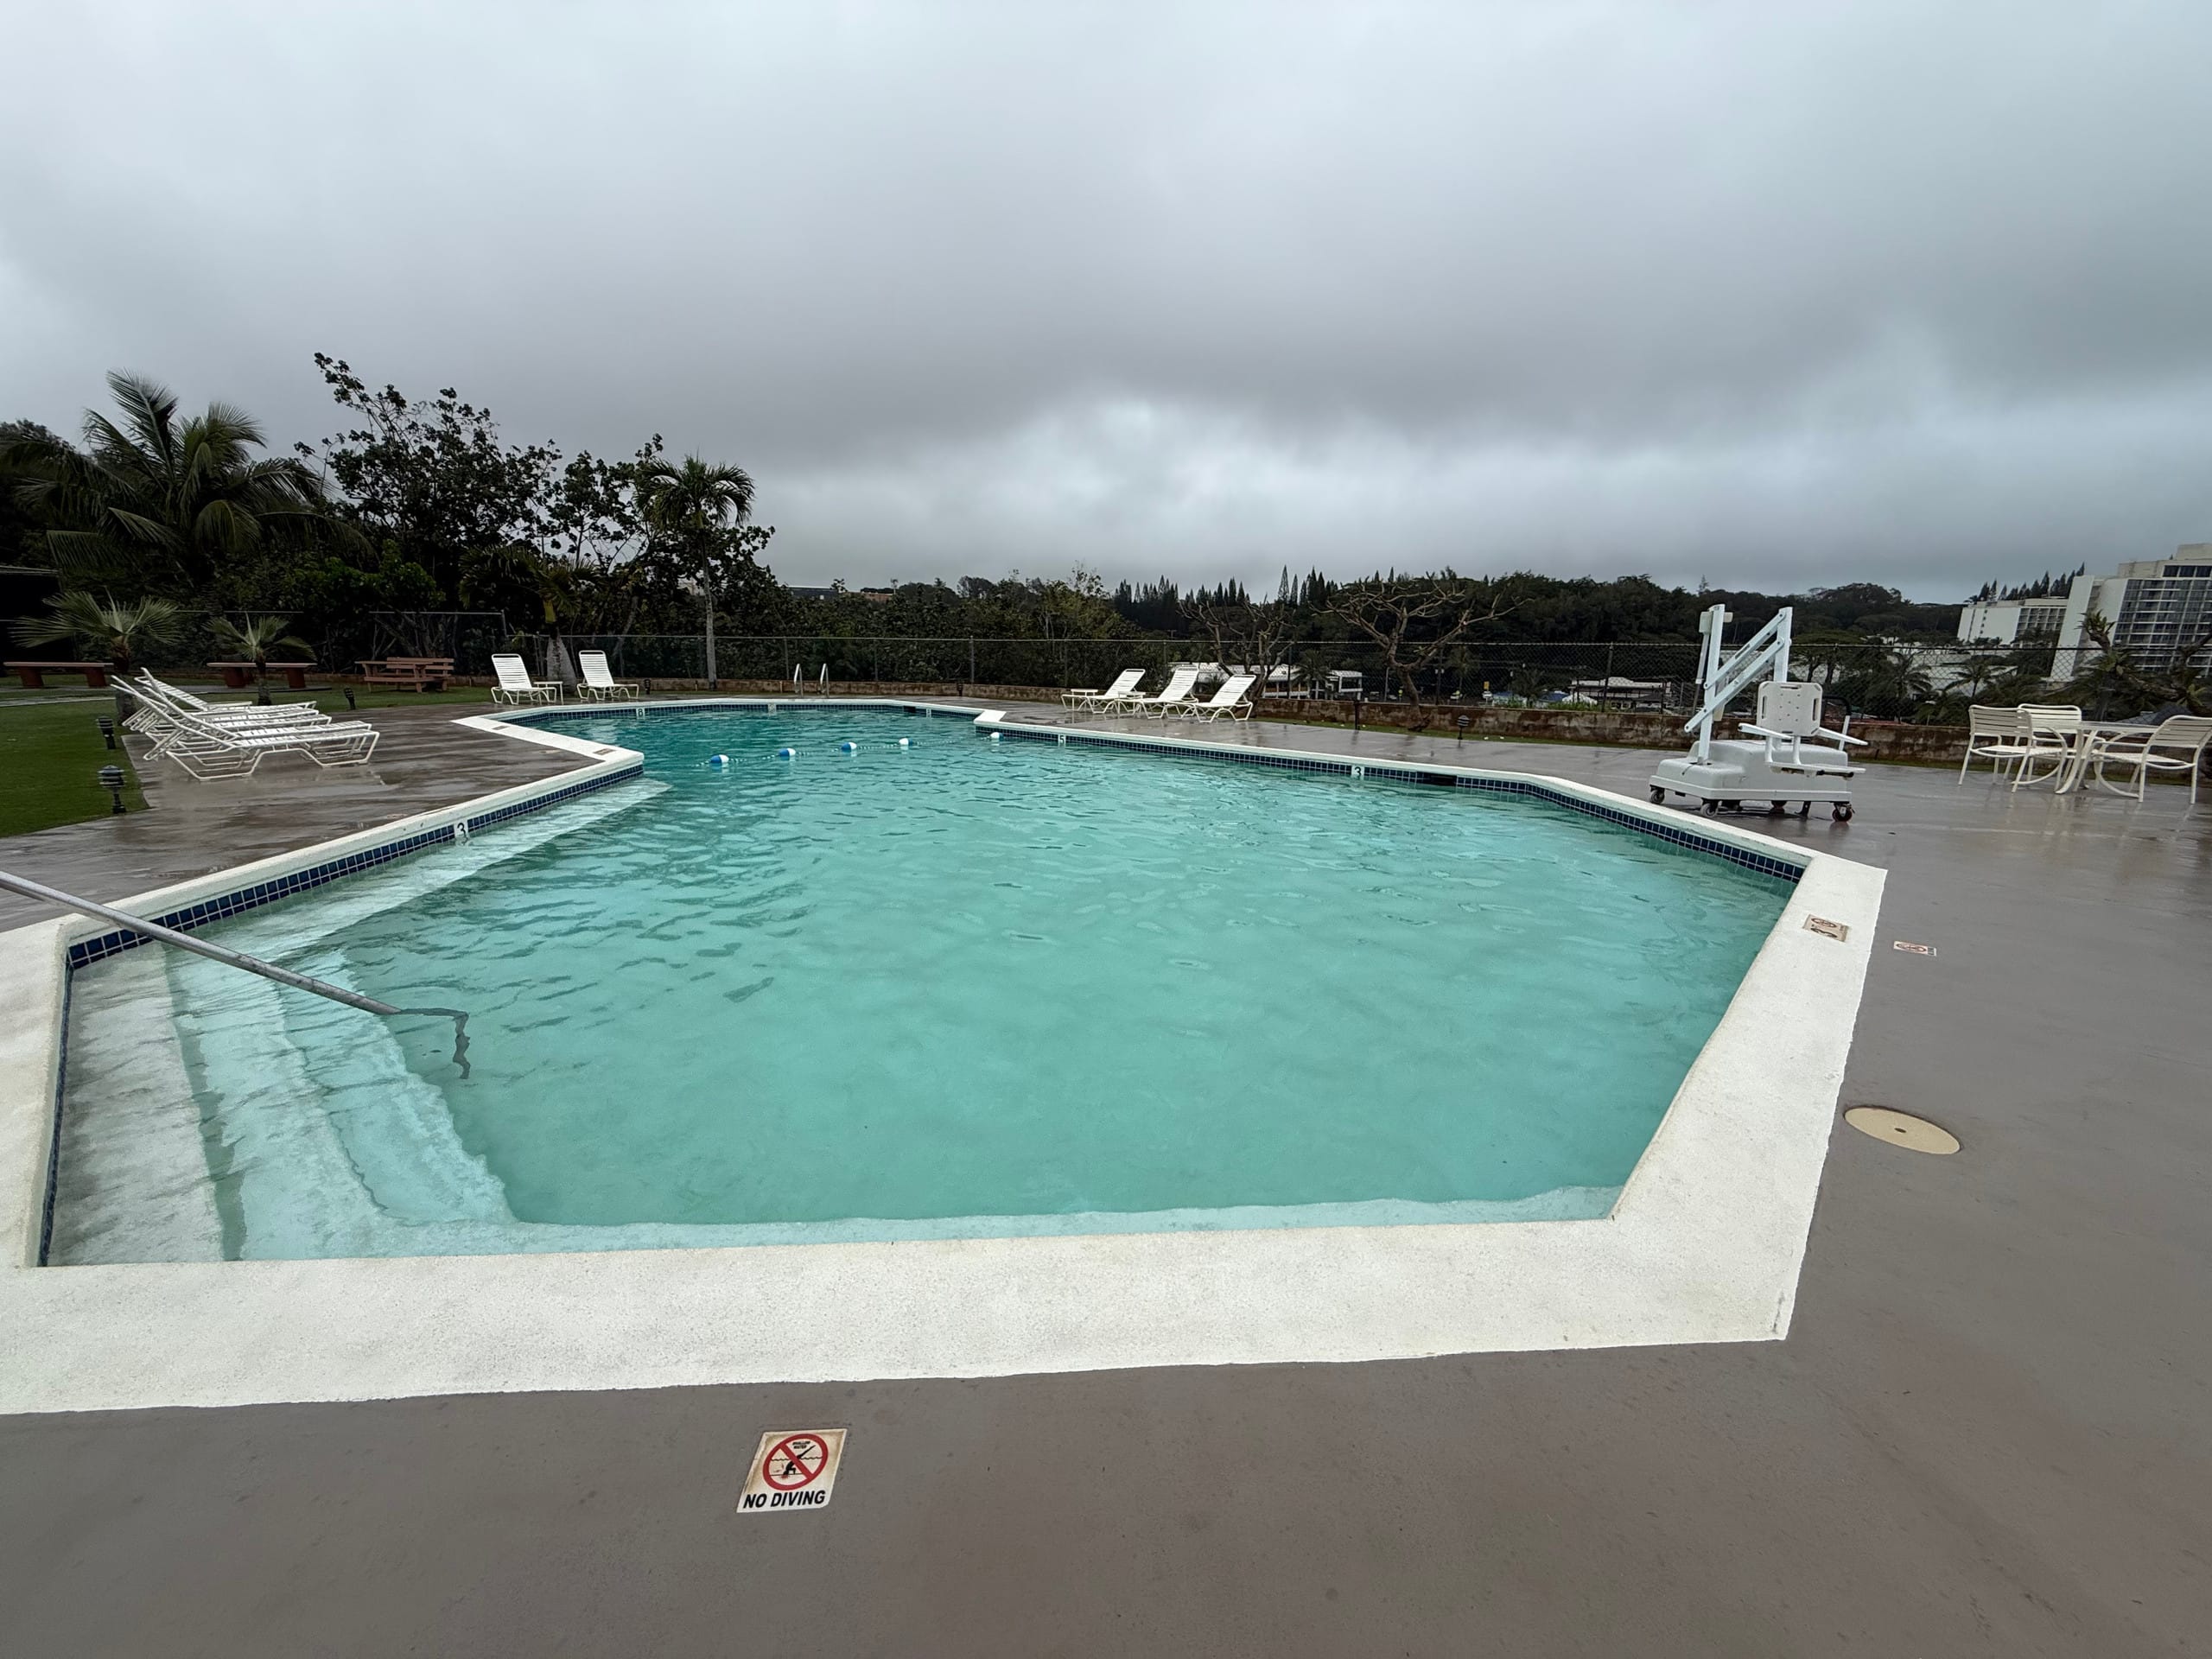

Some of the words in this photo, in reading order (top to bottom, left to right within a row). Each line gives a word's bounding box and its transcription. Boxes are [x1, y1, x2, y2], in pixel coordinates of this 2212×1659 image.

[1059, 735, 1065, 744] 5
[1355, 766, 1362, 775] 3
[457, 823, 467, 838] 3
[743, 1493, 767, 1509] NO
[771, 1490, 826, 1507] DIVING
